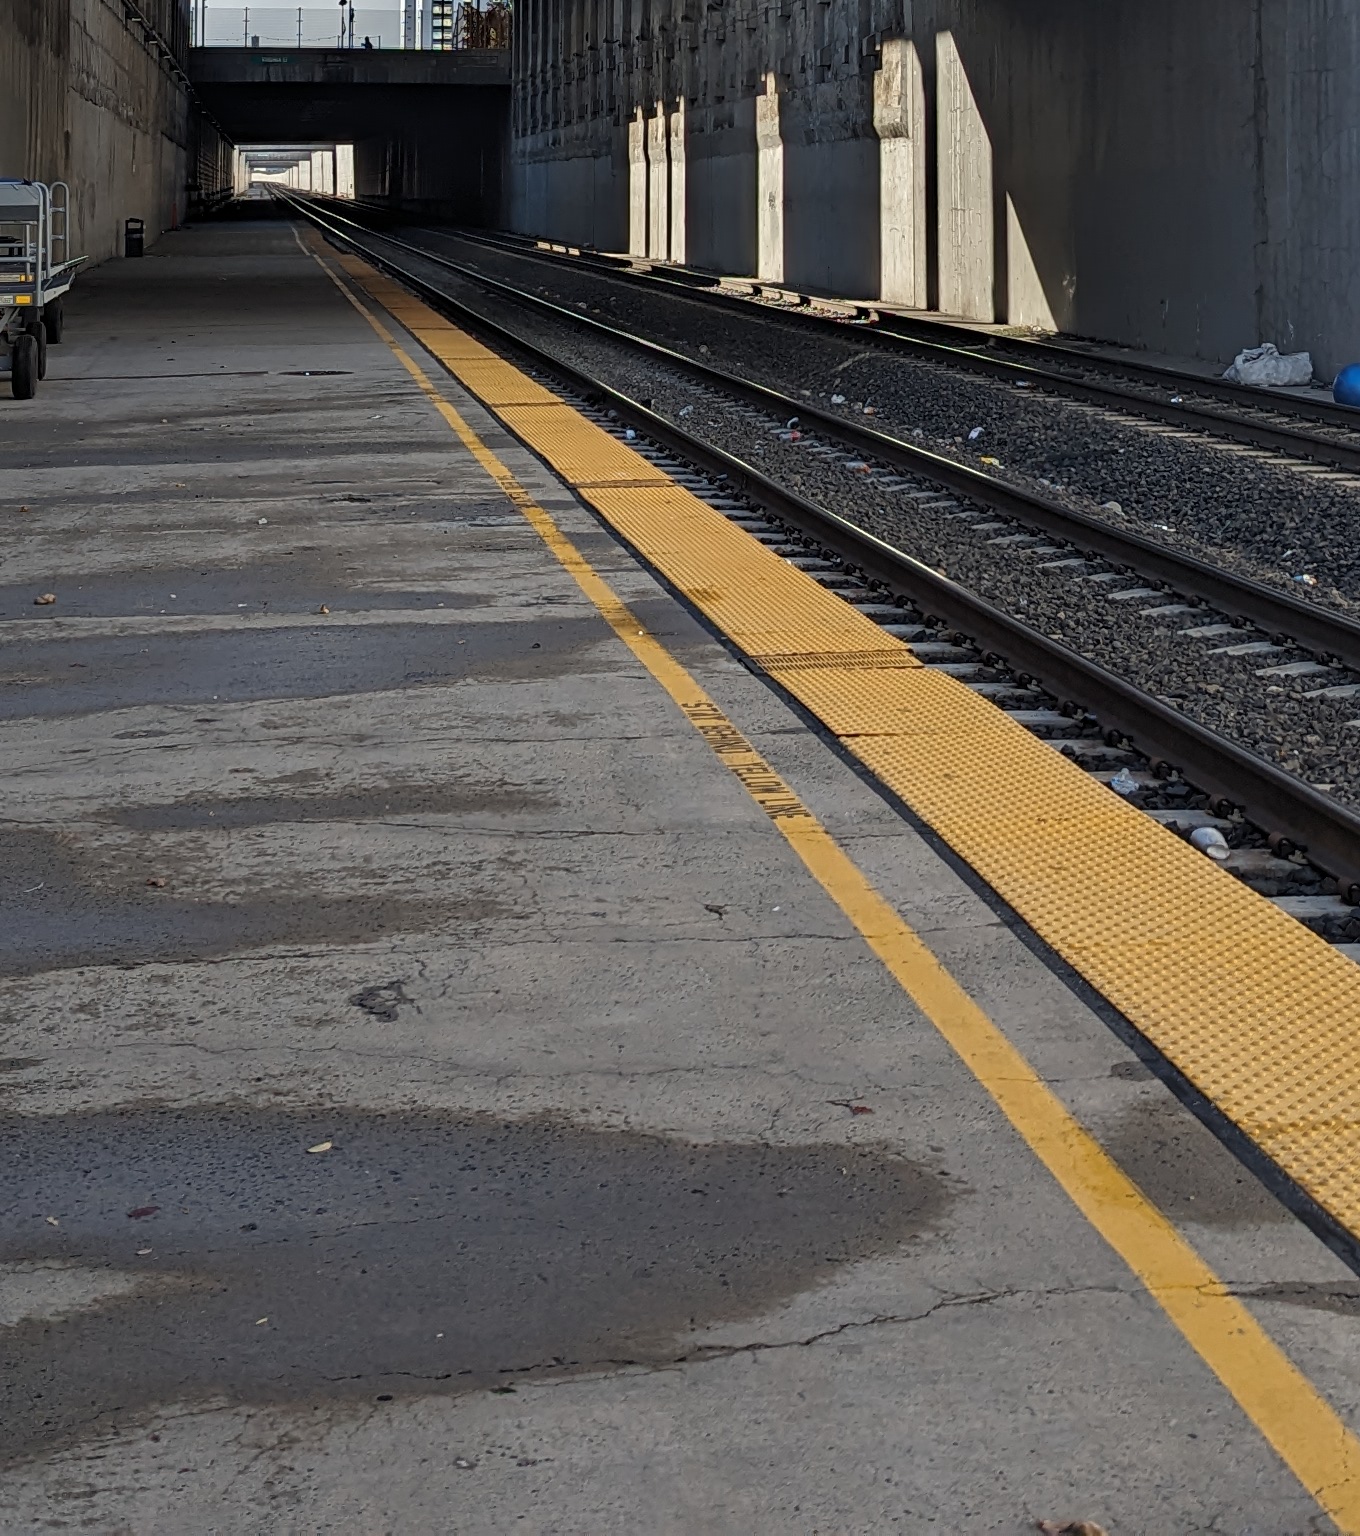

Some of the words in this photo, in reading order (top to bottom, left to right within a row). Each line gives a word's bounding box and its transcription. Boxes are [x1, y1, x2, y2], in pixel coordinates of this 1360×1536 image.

[681, 702, 726, 721] STAY
[698, 725, 753, 754] BEHIND
[726, 761, 790, 794] YELLOW
[758, 797, 812, 819] LINE
